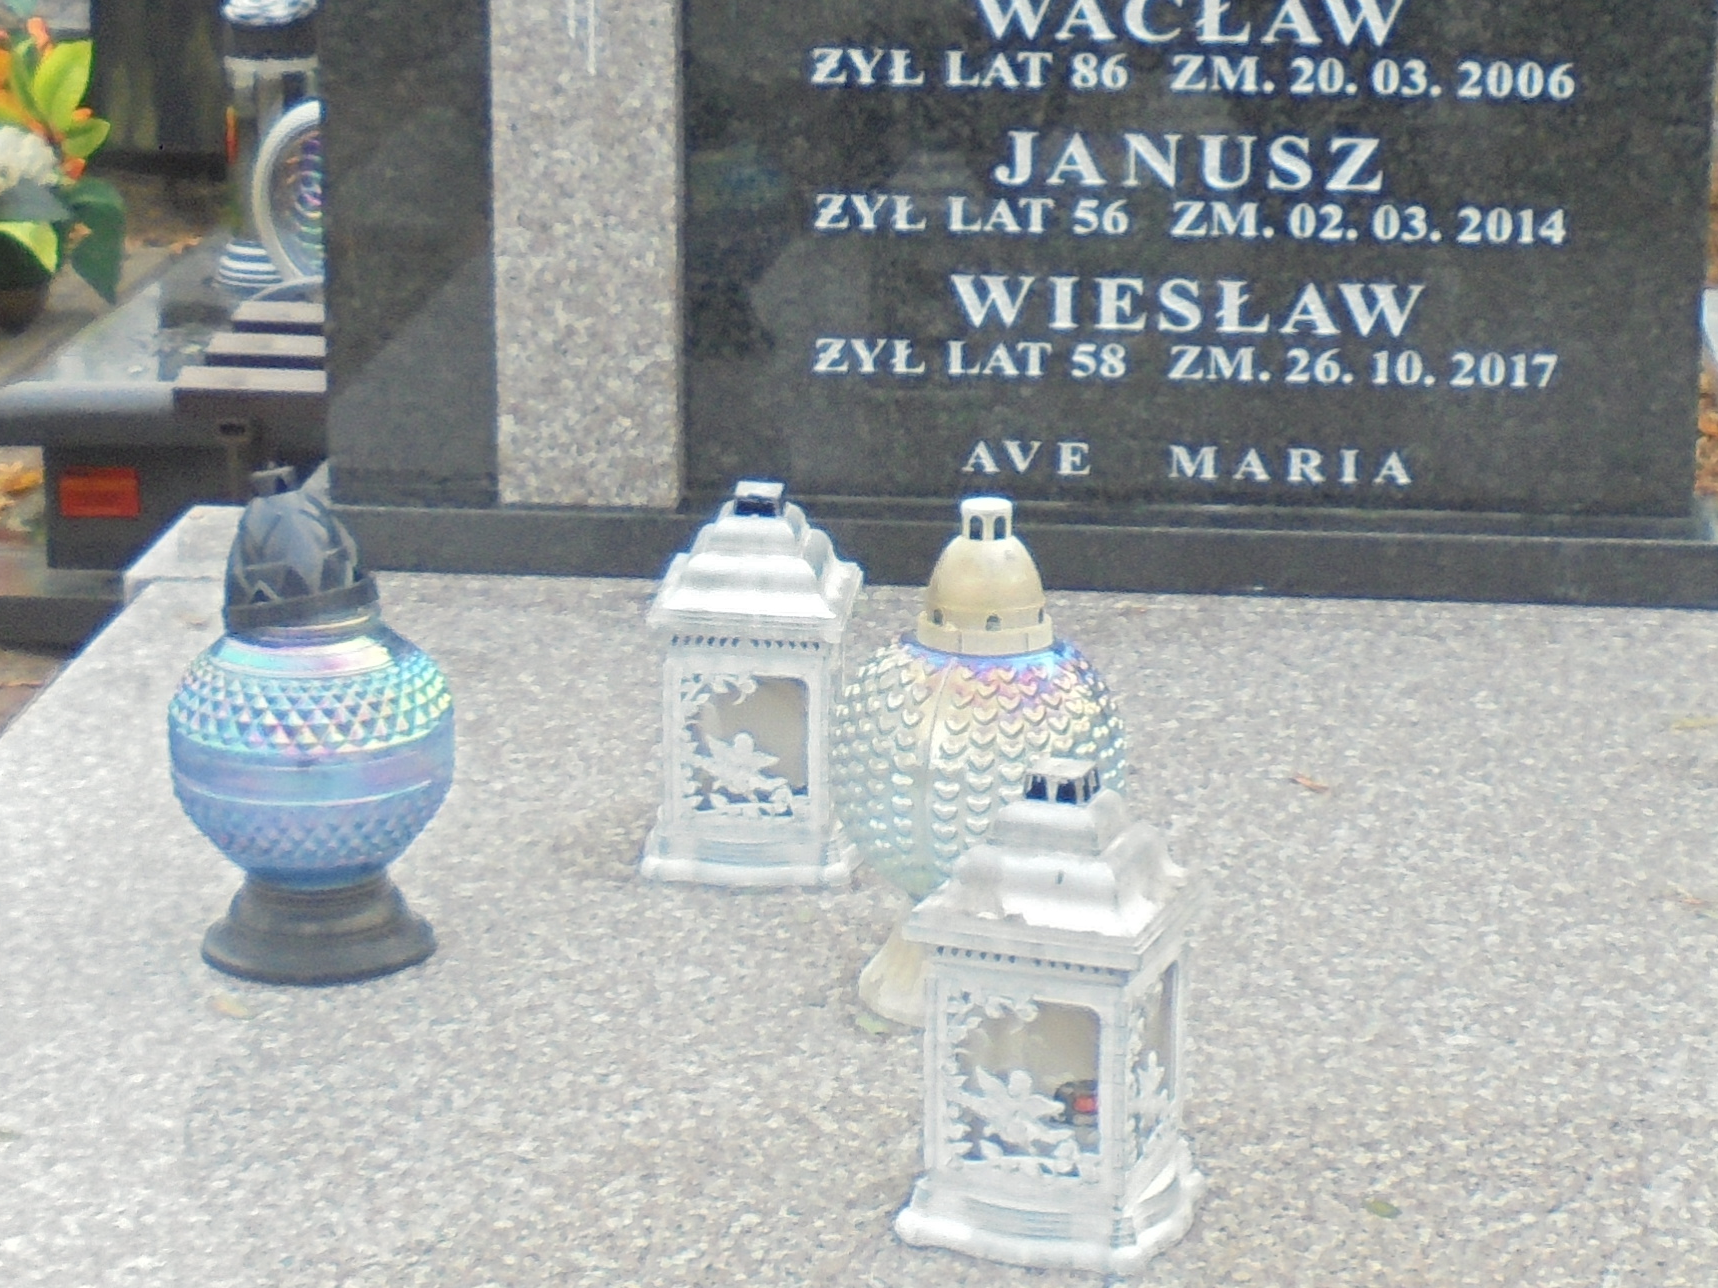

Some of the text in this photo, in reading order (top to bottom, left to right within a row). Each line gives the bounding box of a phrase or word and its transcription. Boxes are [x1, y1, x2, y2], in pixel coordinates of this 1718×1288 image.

[945, 49, 1055, 90] LAT
[1069, 51, 1130, 91] 86
[1169, 53, 1277, 95] ZM.
[1456, 60, 1577, 101] 2006
[992, 128, 1384, 193] JANUSZ
[947, 194, 1057, 236] LAT
[1071, 196, 1131, 237] 56
[1169, 199, 1276, 240] ZM.
[1455, 205, 1568, 246] 2014
[948, 272, 1426, 339] WIESŁAW
[947, 338, 1055, 379] LAT
[1069, 341, 1128, 381] 58
[1166, 343, 1273, 384] ZM.
[1448, 349, 1560, 390] 2017
[961, 439, 1413, 487] AVE MARIA
